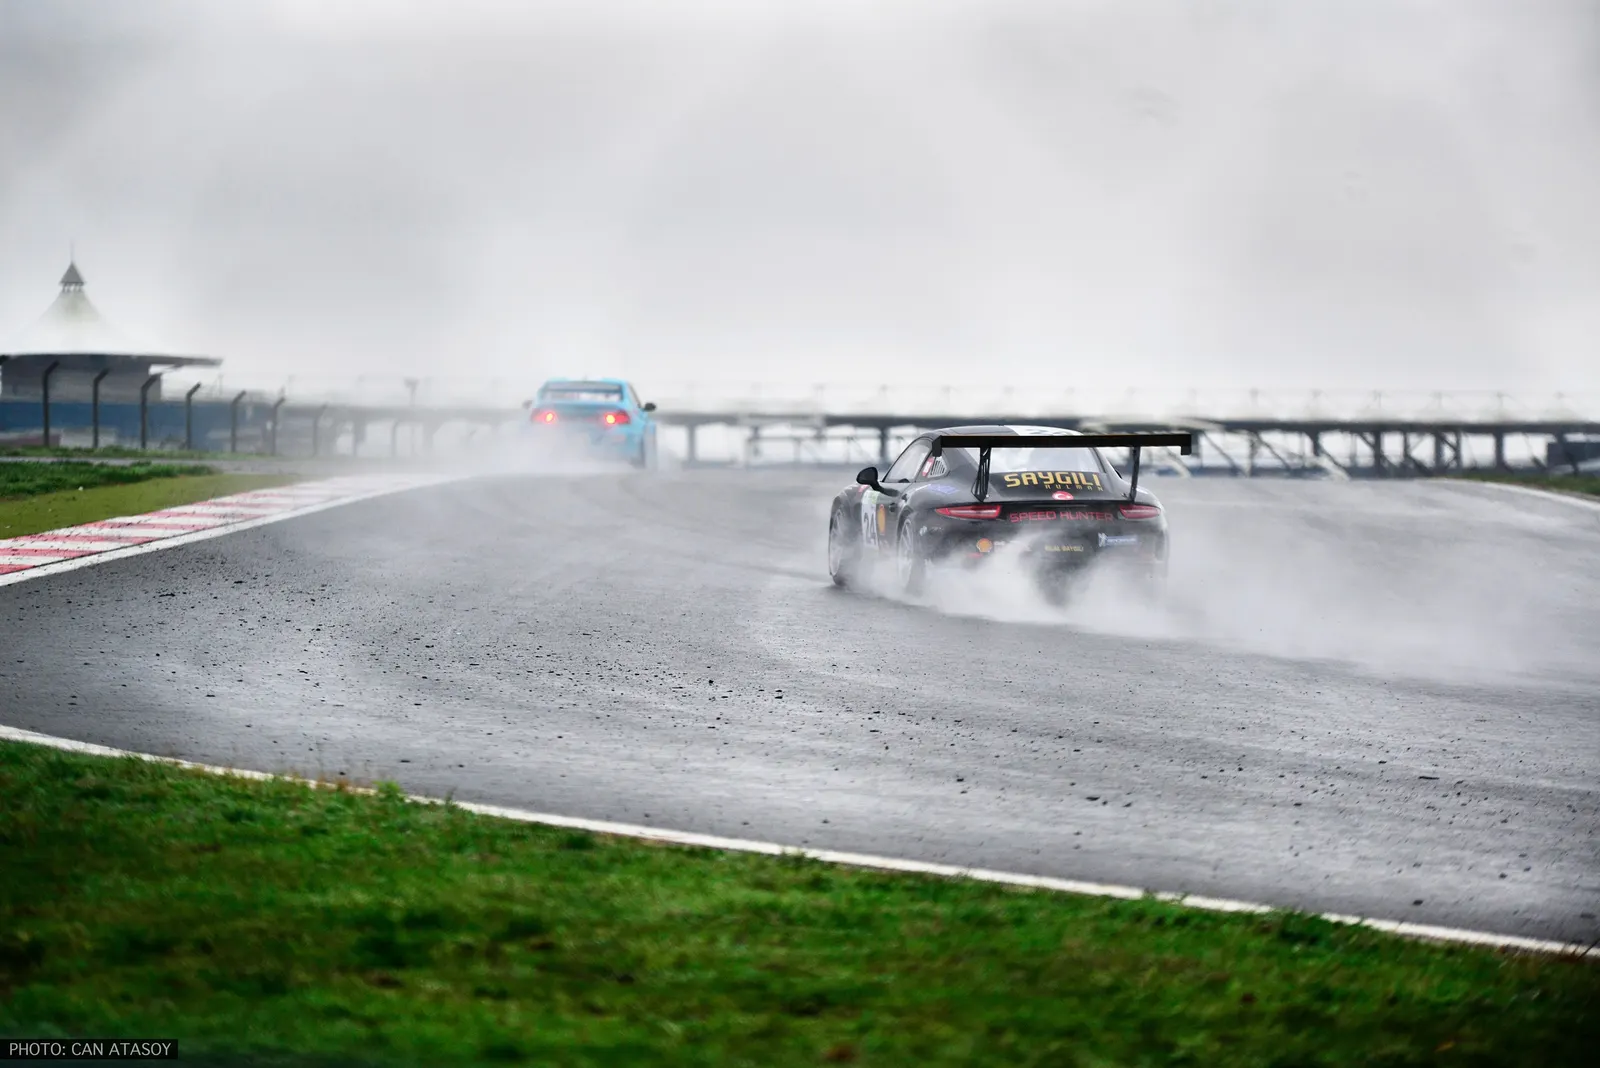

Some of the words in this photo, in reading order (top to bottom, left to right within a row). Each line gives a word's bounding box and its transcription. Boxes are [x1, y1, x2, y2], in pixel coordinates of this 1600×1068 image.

[1003, 471, 1101, 488] SAYGILI
[1009, 511, 1056, 523] SPEED
[1060, 511, 1114, 523] HUNTER
